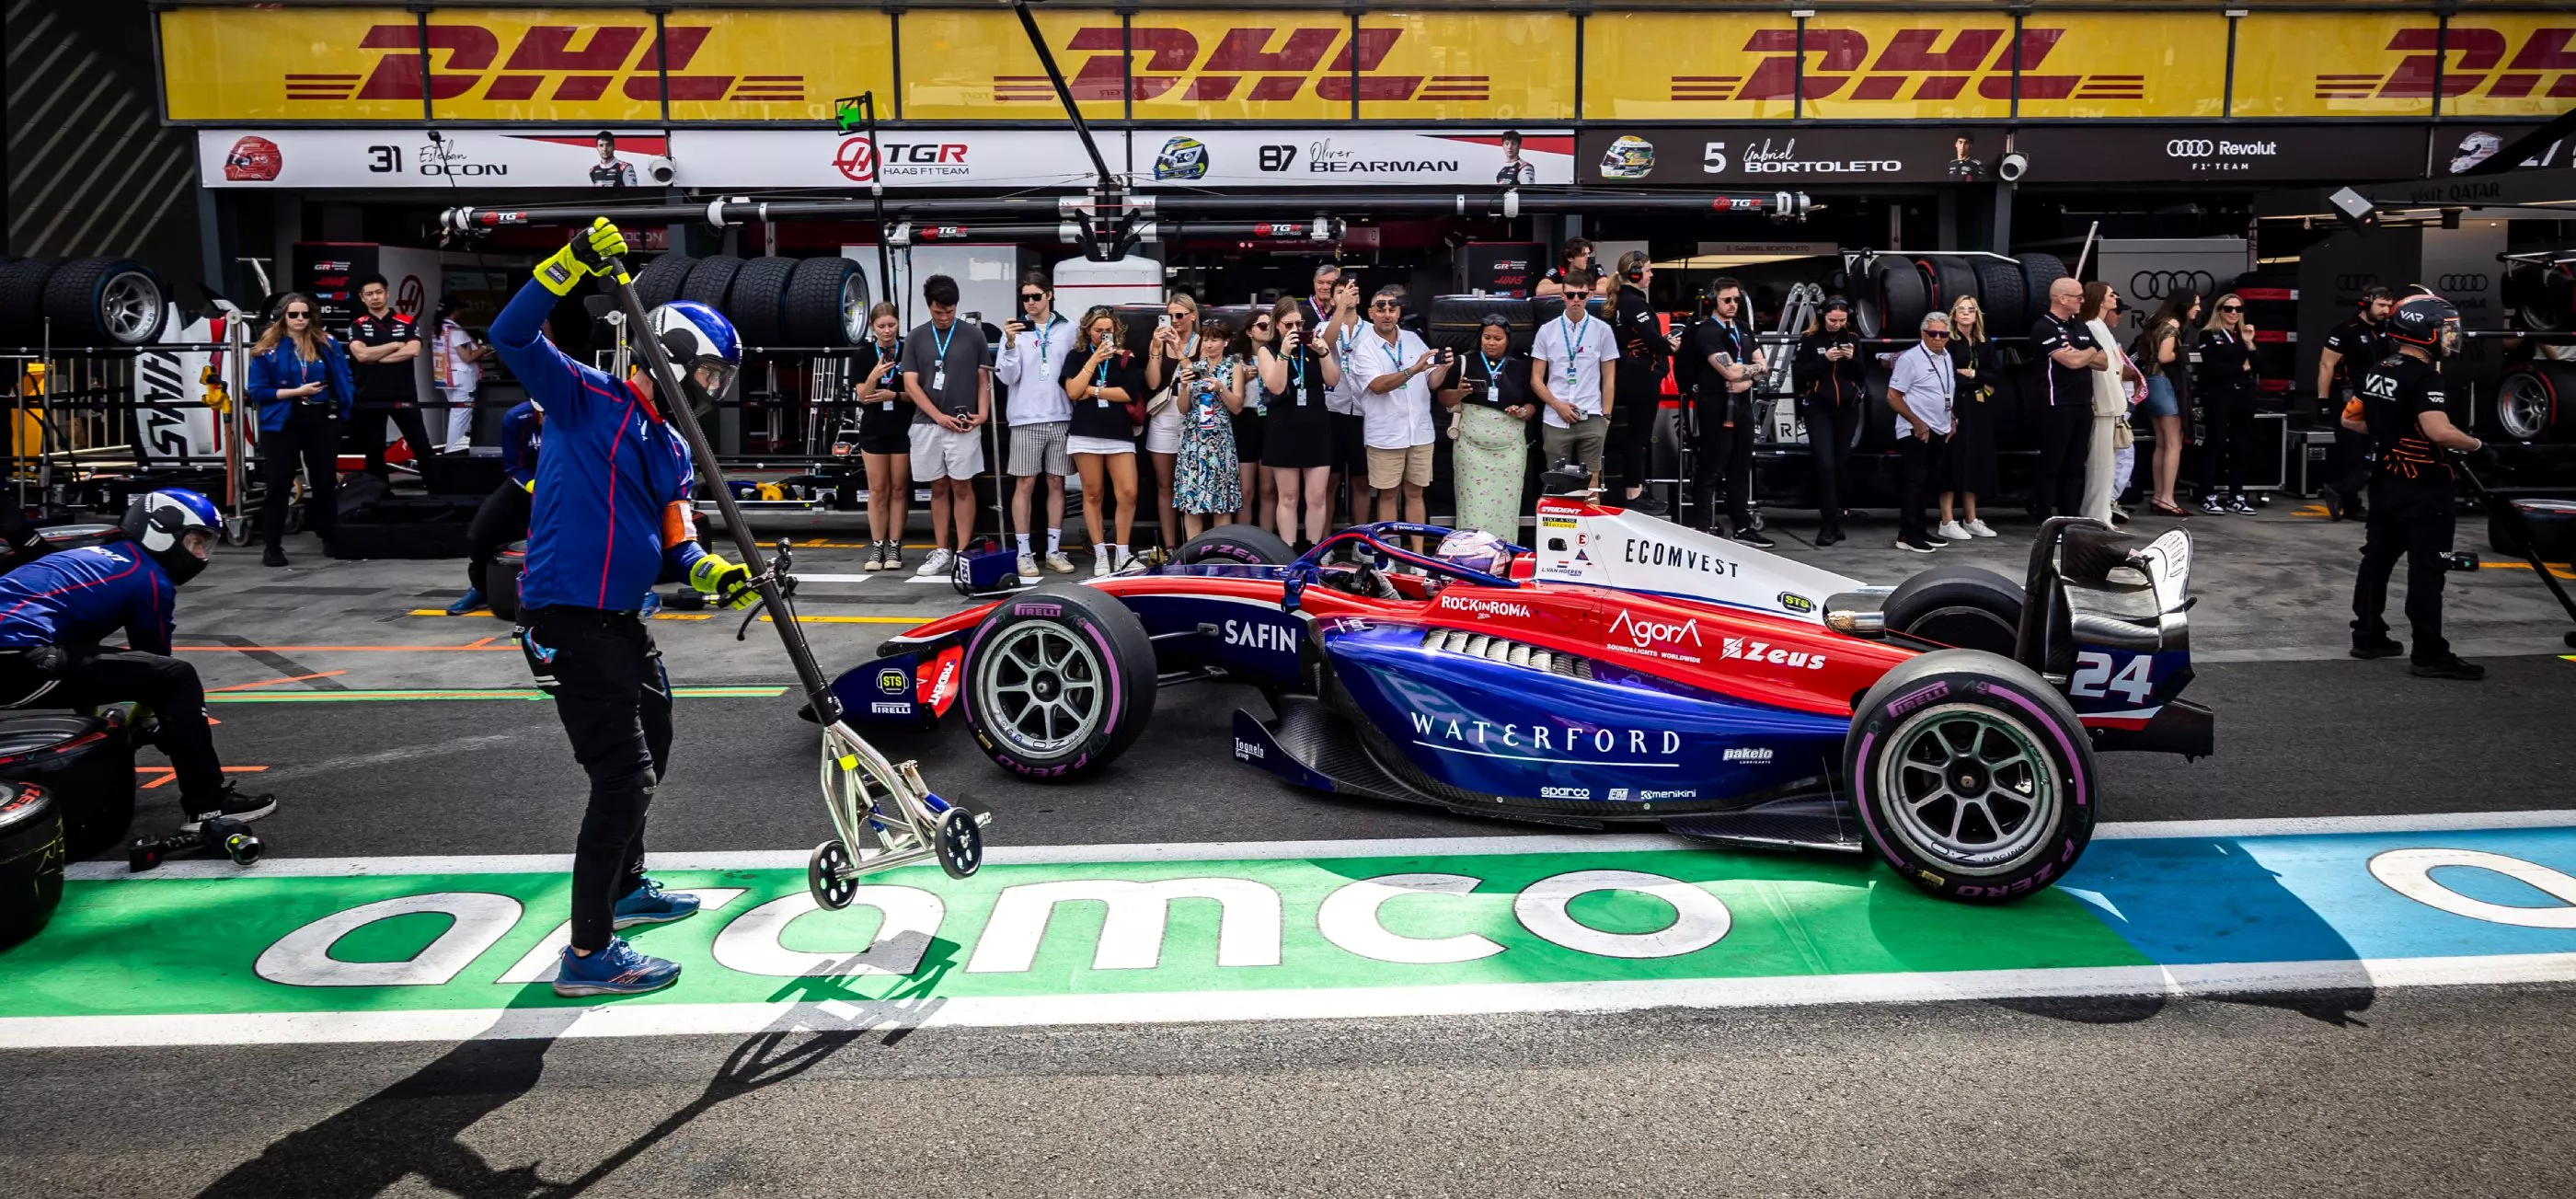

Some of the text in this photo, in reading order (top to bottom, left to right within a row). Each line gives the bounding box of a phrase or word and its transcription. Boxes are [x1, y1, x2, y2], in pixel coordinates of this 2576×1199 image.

[357, 25, 736, 101] DHL
[1064, 28, 1426, 101] DHL
[1735, 29, 2083, 100] DHL
[2375, 28, 2576, 98] DH
[883, 144, 968, 163] TGR
[1310, 138, 1354, 162] Oliver
[1743, 138, 1795, 162] Gabriel
[2219, 140, 2277, 156] Revolut
[368, 145, 402, 173] 31
[1259, 145, 1297, 172] 87
[1310, 161, 1458, 173] BEARMAN
[1703, 143, 1727, 173] 5
[1744, 161, 1902, 173] BORTOLETO
[420, 164, 508, 176] OCON
[883, 167, 970, 176] HAAS F1 TEAM
[2449, 182, 2501, 201] QATAR
[1730, 199, 1762, 207] TGR
[498, 212, 528, 220] TGR
[1271, 224, 1302, 232] TGR
[2400, 310, 2424, 322] VAR
[2365, 374, 2398, 397] VAR
[1541, 506, 1582, 514] TRIDENT
[1218, 545, 1261, 564] ZER
[1625, 539, 1739, 578] ECOMVEST
[1015, 603, 1063, 617] PIRELLI
[1785, 595, 1810, 608] STS
[1225, 618, 1296, 653] SAFIN
[1606, 643, 1701, 663] SOUND&LIGHTS WORLDWIDE
[1743, 642, 1826, 670] Zeus
[883, 676, 902, 686] STS
[927, 659, 957, 706] TRIDENT
[2069, 651, 2153, 703] 24
[871, 702, 911, 714] PIRELLI
[1886, 680, 1949, 718] PIRELLI
[1410, 711, 1681, 755] WATERFORD
[1722, 748, 1774, 760] pakelo
[1540, 787, 1590, 798] sparco
[1651, 790, 1696, 798] menikini
[198, 810, 222, 821] HOKA
[252, 869, 1733, 987] aramco
